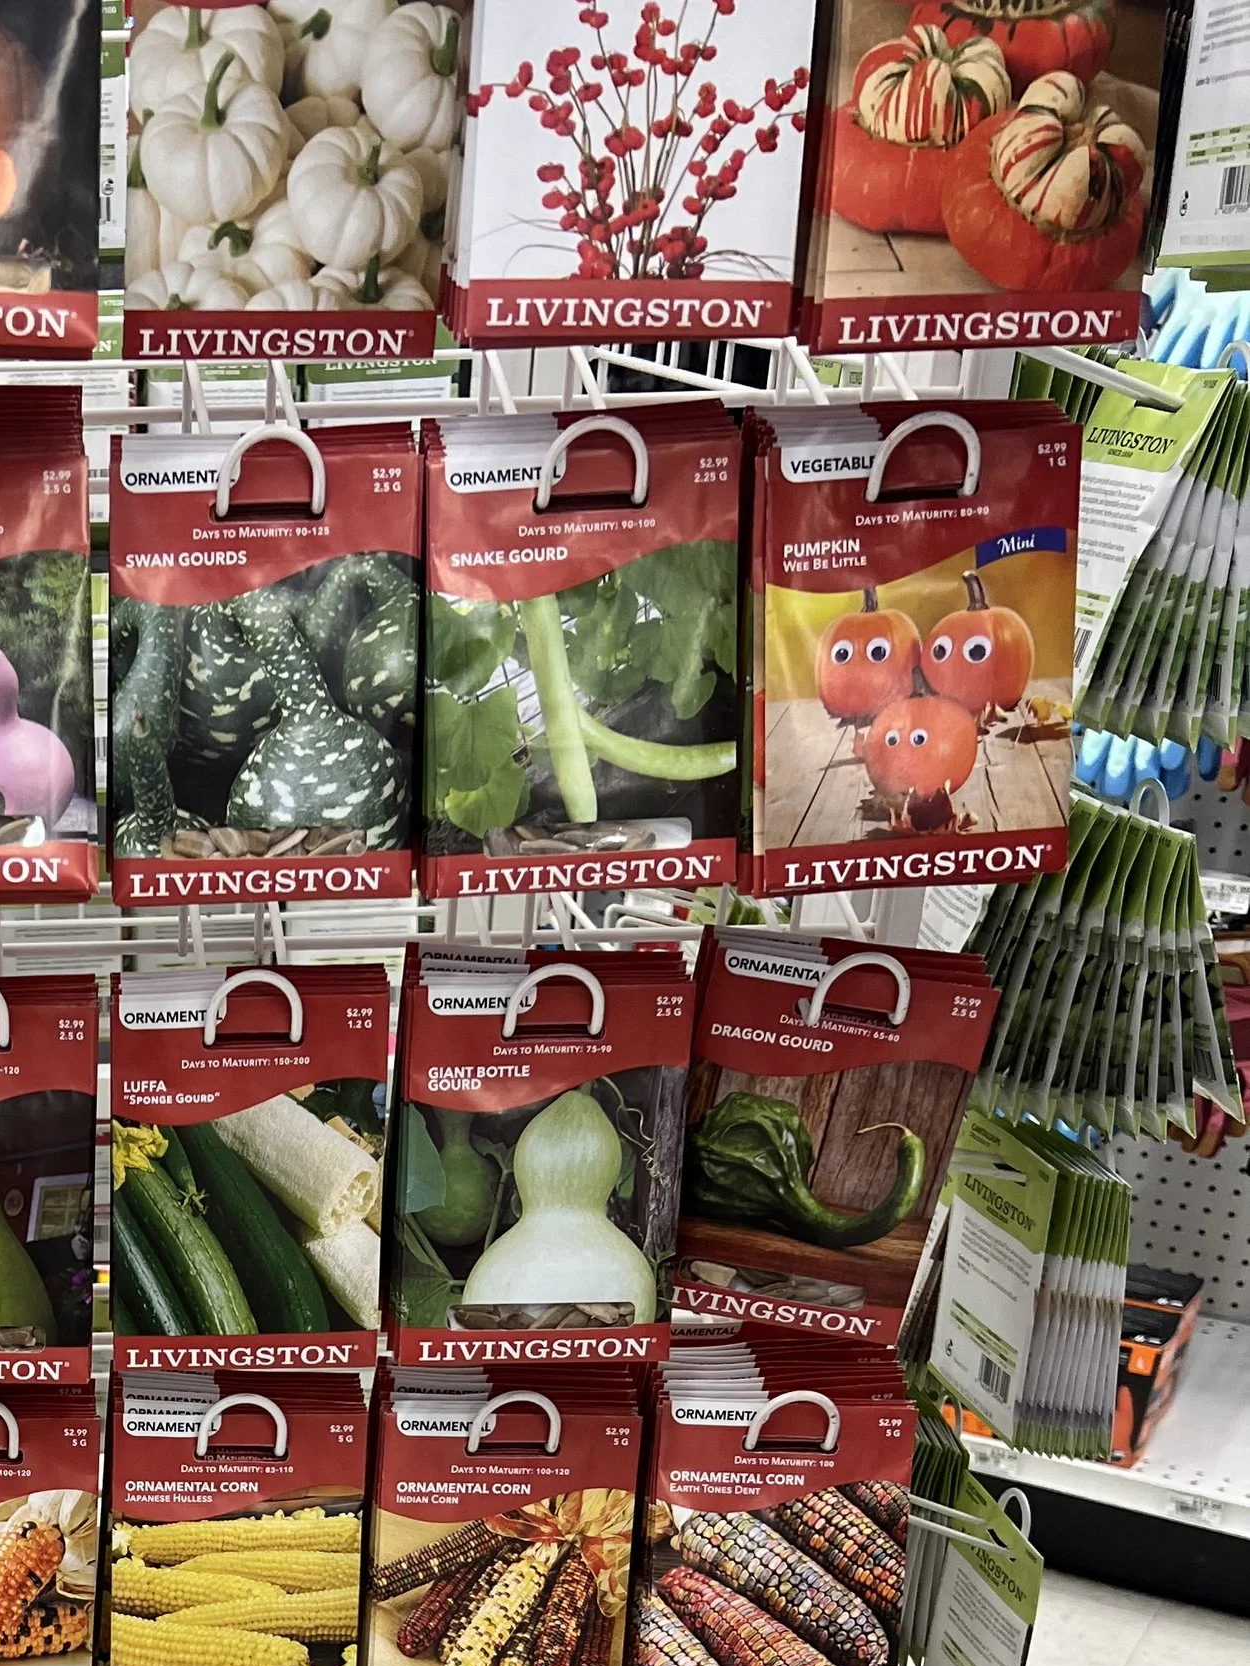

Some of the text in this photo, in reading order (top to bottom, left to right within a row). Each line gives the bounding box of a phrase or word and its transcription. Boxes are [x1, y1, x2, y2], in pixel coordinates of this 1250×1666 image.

[487, 298, 764, 330] LIVINGSTON
[839, 310, 1114, 345] LIVINGSTON
[138, 327, 406, 357] LIVINGSTON
[1086, 426, 1173, 455] LIVINGSTON
[700, 457, 728, 469] $2.99
[43, 471, 71, 481] $2.99
[373, 468, 401, 479] $2.99
[450, 466, 560, 487] ORNAMENTL
[783, 538, 860, 558] PUMPKIN
[997, 534, 1035, 556] Mini
[126, 550, 247, 568] SWAN GOURDS
[451, 546, 568, 568] SNAKE GOURD
[458, 857, 716, 893] LIVINGSTON
[785, 848, 1047, 888] LIVINGSTON
[129, 867, 383, 897] LIVINGSTON
[656, 996, 683, 1006] $2.99
[954, 995, 981, 1008] $2.99
[346, 1008, 372, 1018] $2.99
[58, 1019, 85, 1030] $2.99
[711, 1023, 834, 1053] DRAGON GOURD
[428, 1065, 530, 1080] GIANT BOTTLE
[123, 1080, 167, 1093] LUFFA
[428, 1079, 481, 1092] GOURD
[965, 1174, 1035, 1232] LIVINGSTON
[671, 1284, 876, 1338] IVINGSTON
[126, 1346, 353, 1369] LIVINGSTON
[419, 1336, 653, 1362] LIVINGSTON
[878, 1418, 902, 1427] $2.99
[64, 1429, 87, 1437] $2.99
[125, 1481, 258, 1492] ORNAMENTAL CORN
[670, 1470, 804, 1485] ORNAMENTAL CORN
[397, 1482, 531, 1494] ORNAMENTAL CORN
